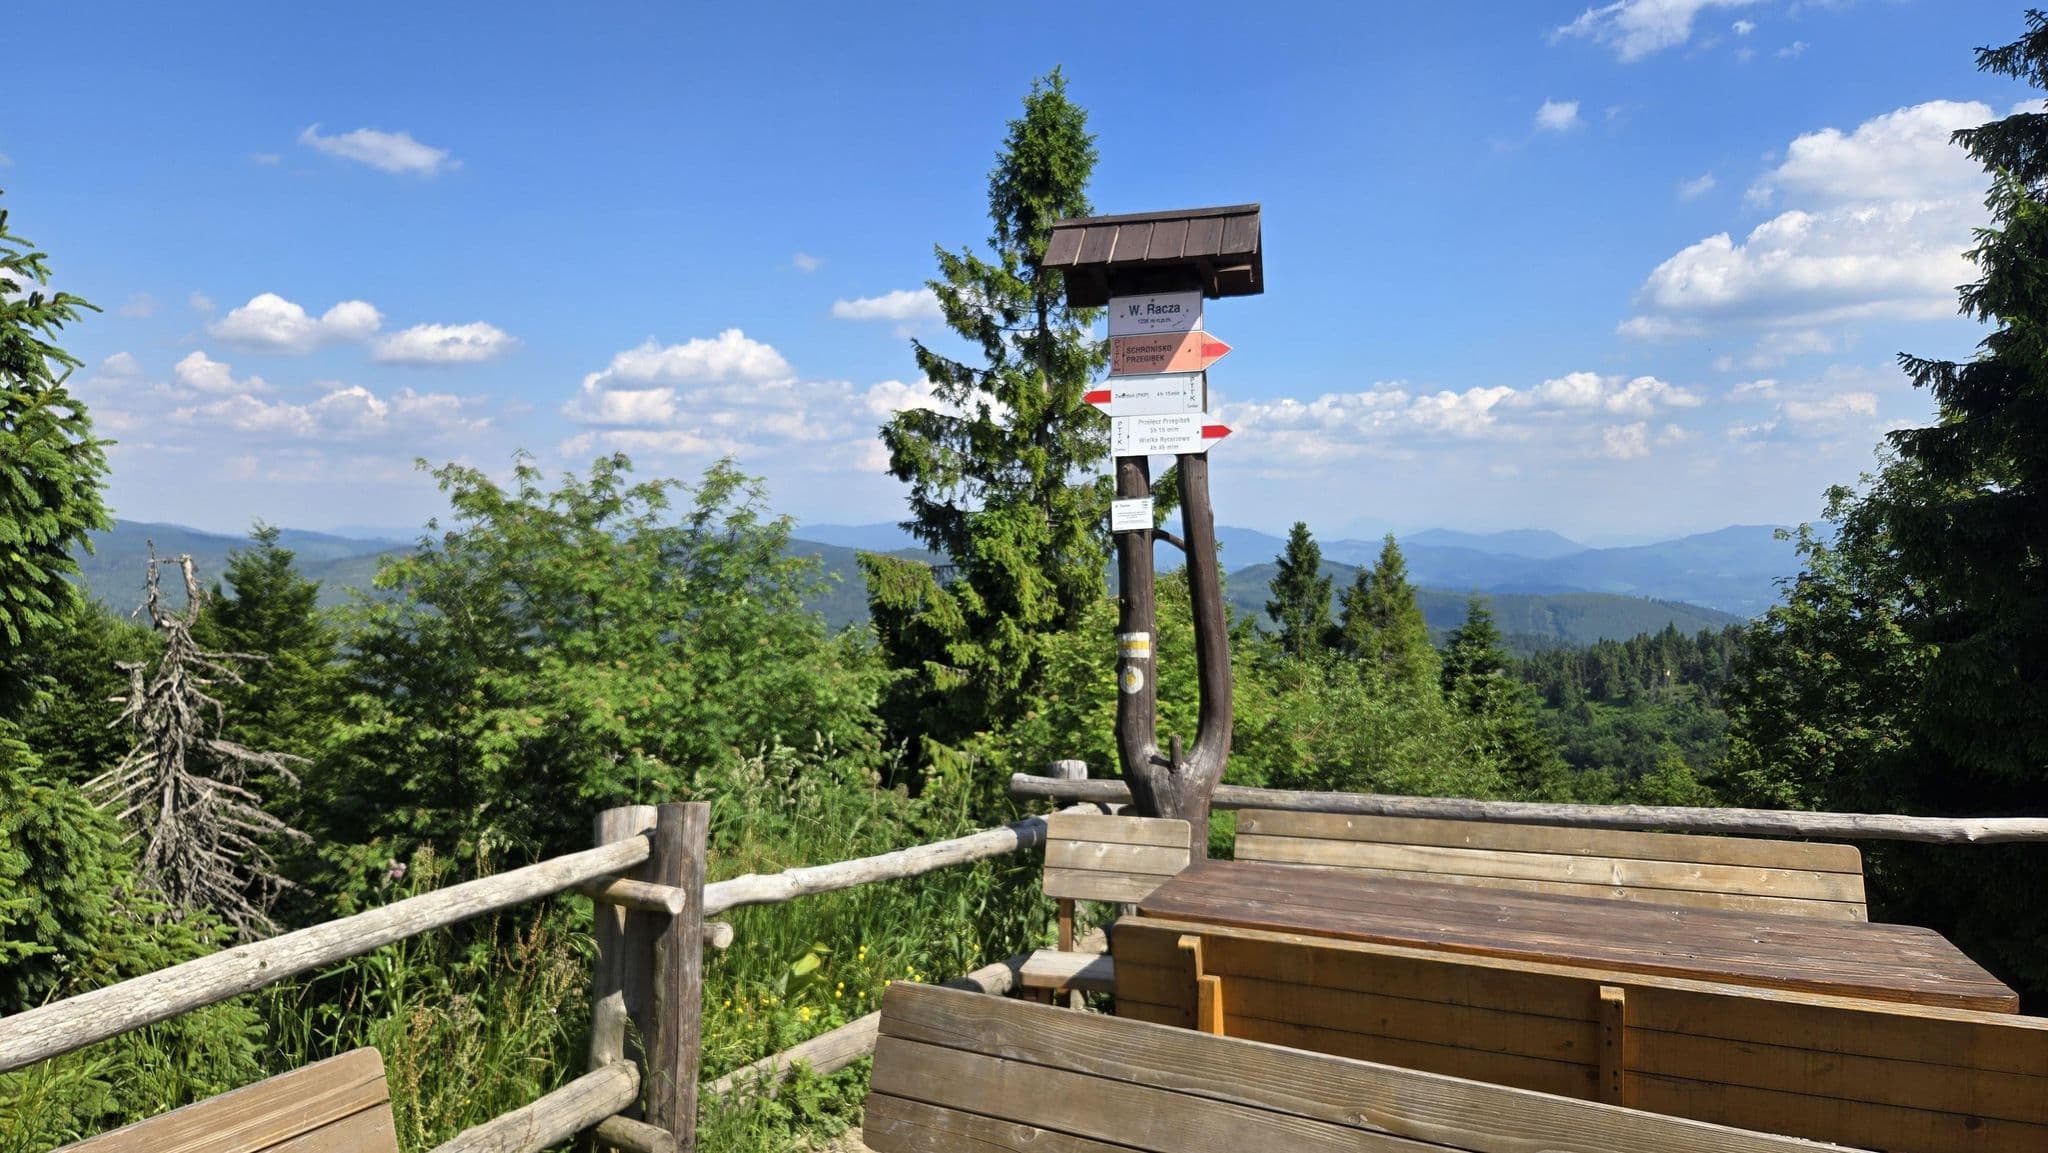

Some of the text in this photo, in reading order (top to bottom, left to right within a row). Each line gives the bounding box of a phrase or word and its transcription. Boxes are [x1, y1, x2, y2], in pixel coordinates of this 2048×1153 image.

[1128, 303, 1181, 317] W. Racza
[1126, 344, 1172, 355] SCHRONISKO
[1126, 354, 1165, 364] PRZEGIBEK
